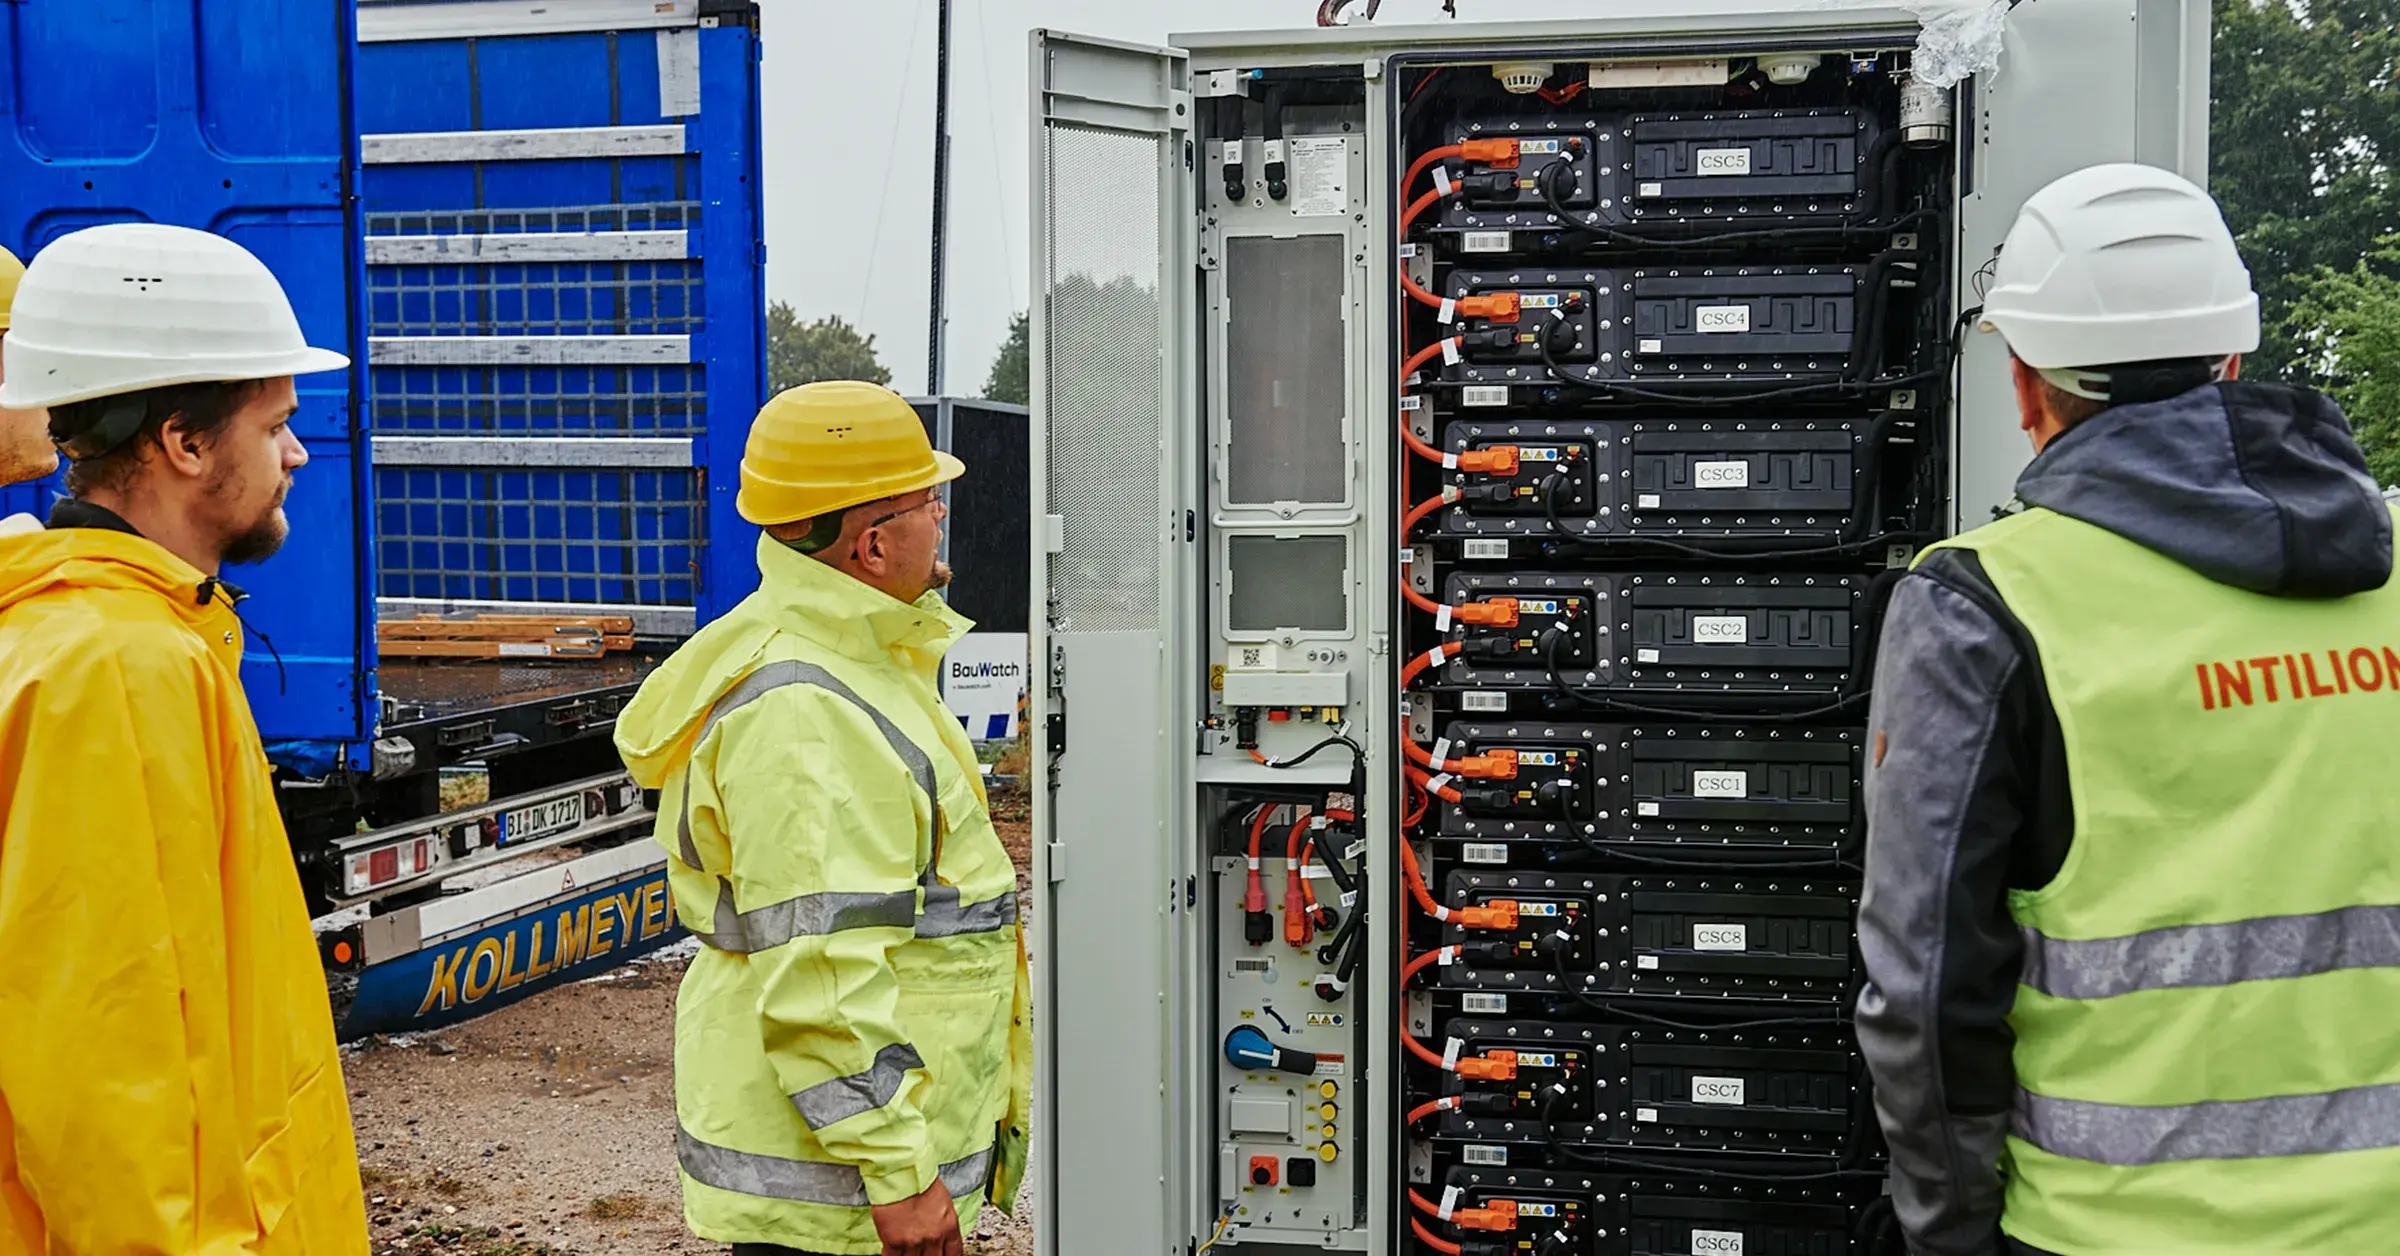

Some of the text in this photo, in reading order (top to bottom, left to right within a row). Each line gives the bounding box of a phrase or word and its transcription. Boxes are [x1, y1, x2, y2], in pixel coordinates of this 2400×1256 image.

[1700, 154, 1745, 168] CSC5
[1702, 312, 1745, 325] CSC4
[1700, 467, 1745, 482] CSC3
[1698, 622, 1743, 637] CSC2
[952, 661, 1020, 678] BauWatch
[1697, 777, 1741, 791] CSC1
[507, 813, 522, 837] BI
[532, 805, 548, 831] DK
[550, 797, 579, 826] 1717
[1698, 930, 1743, 945] CSC8
[1696, 1082, 1741, 1098] CSC7
[1695, 1237, 1740, 1252] CSC6
